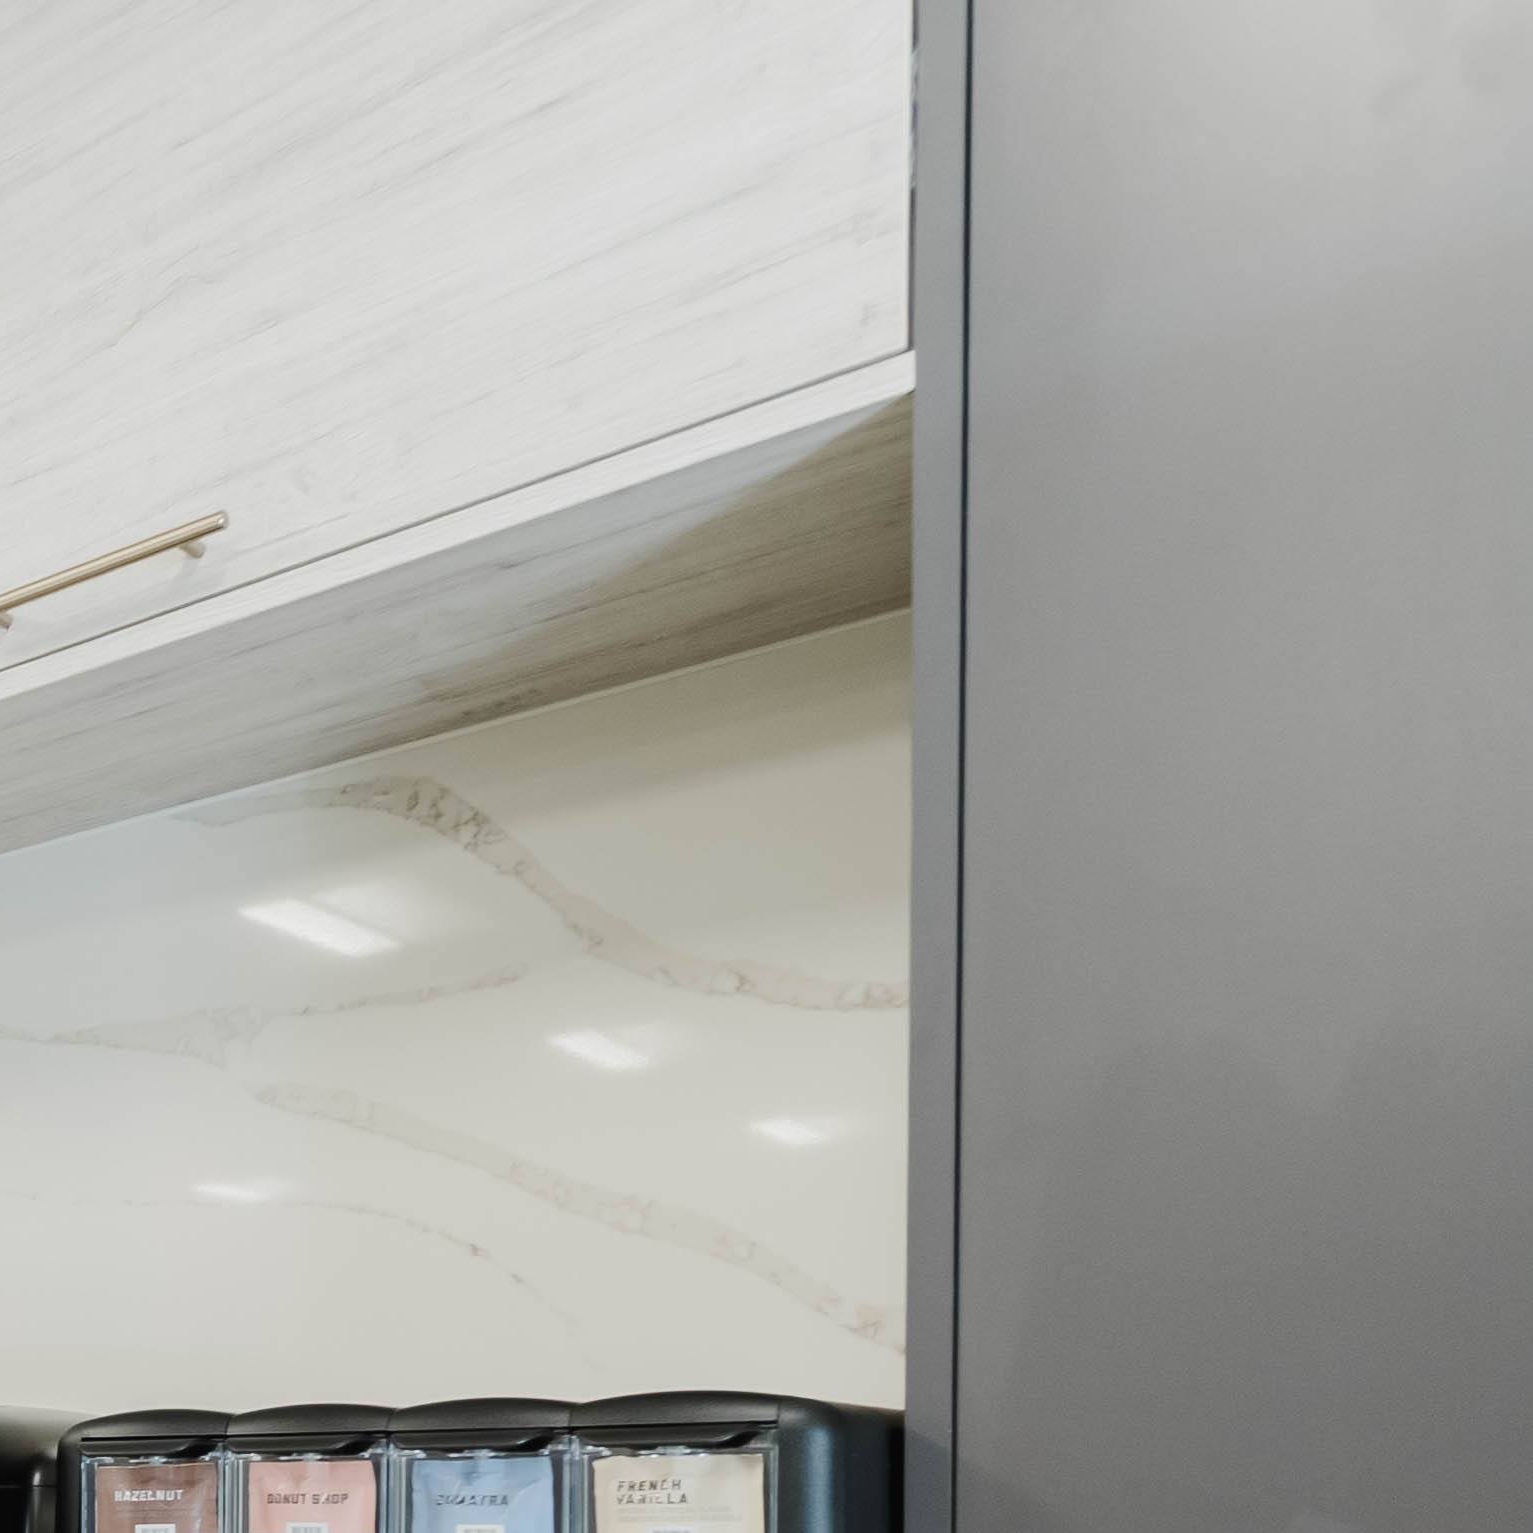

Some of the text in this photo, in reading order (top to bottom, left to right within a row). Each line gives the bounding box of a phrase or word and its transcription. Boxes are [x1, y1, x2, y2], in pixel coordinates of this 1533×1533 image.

[617, 1479, 682, 1492] FRENCH
[114, 1489, 184, 1501] HAZELNUT
[267, 1493, 349, 1505] DONUT SHOP
